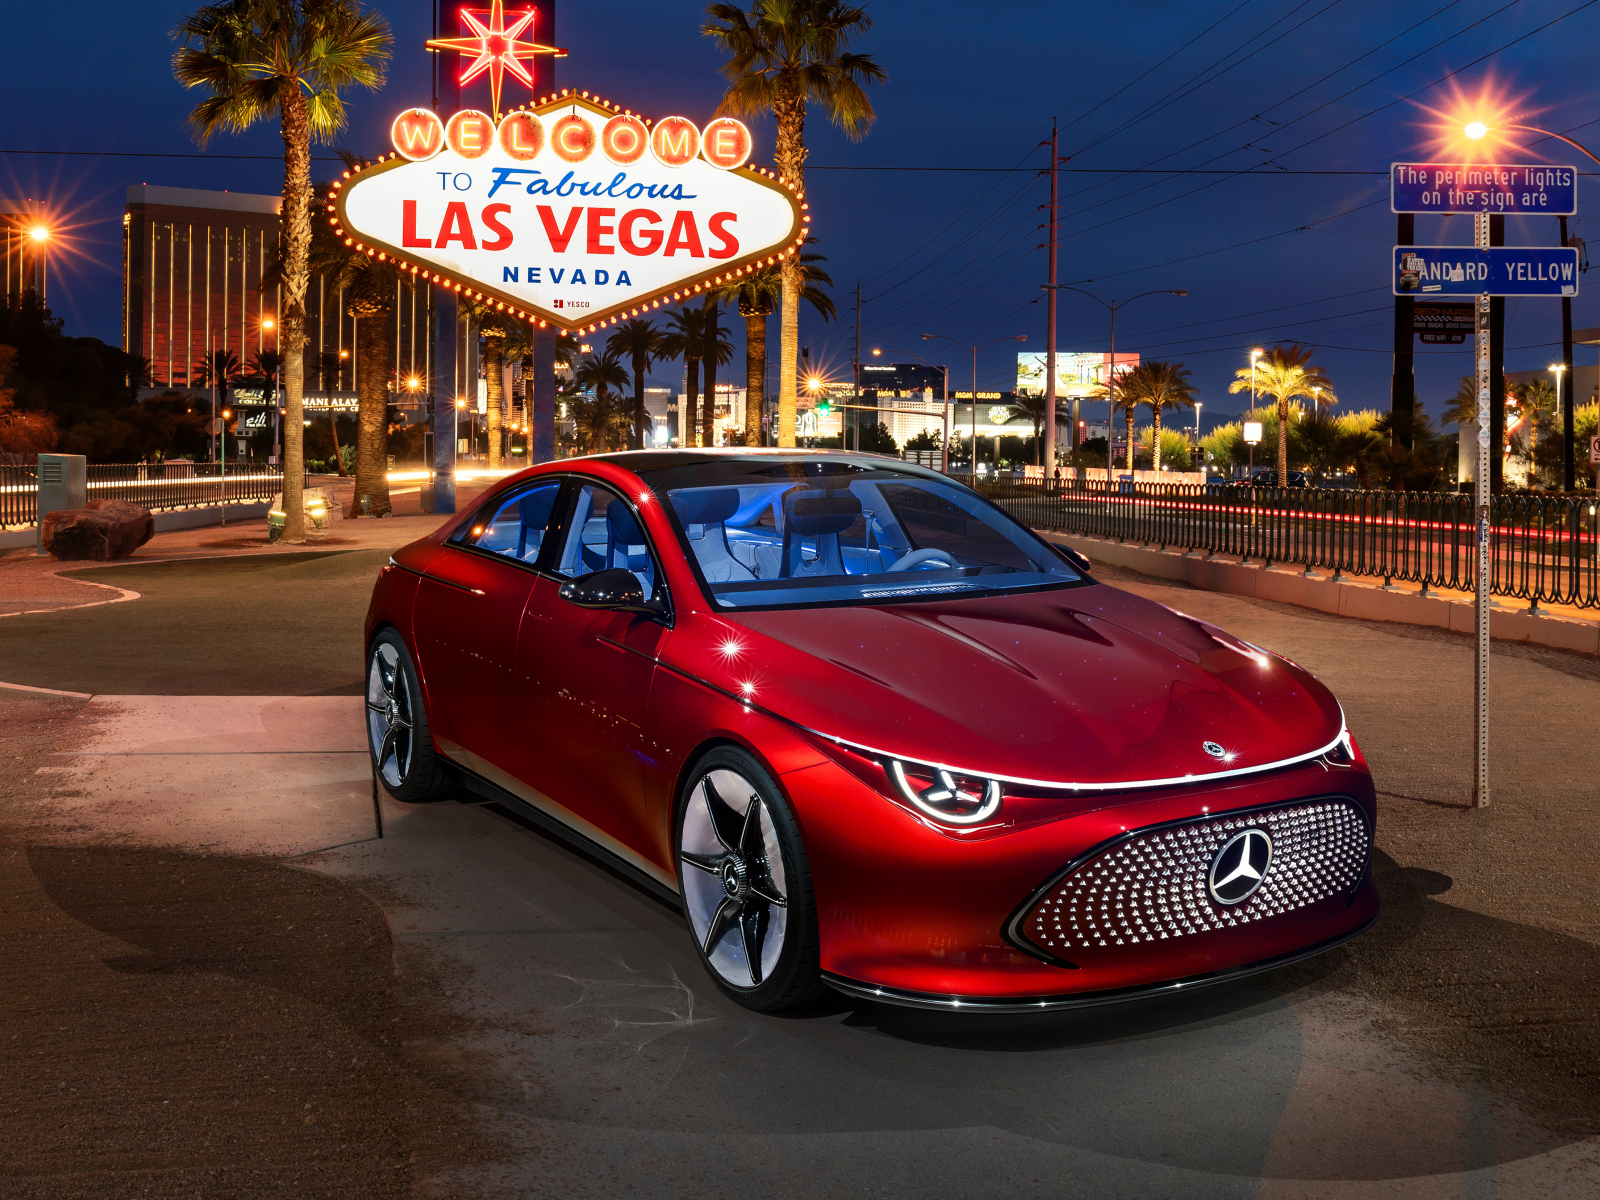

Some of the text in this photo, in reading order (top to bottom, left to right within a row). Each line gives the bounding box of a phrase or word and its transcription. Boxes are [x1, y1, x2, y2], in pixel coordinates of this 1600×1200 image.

[402, 121, 741, 160] WELCOME
[436, 167, 698, 200] TO Fabulous
[1397, 165, 1571, 191] The perimeter lights
[1421, 189, 1547, 212] on the sign are
[401, 199, 741, 260] LAS VEGAS
[502, 266, 633, 287] NEVADA
[1399, 262, 1489, 281] ANDRD
[1505, 262, 1574, 281] YELLOW
[566, 300, 590, 308] YESCO
